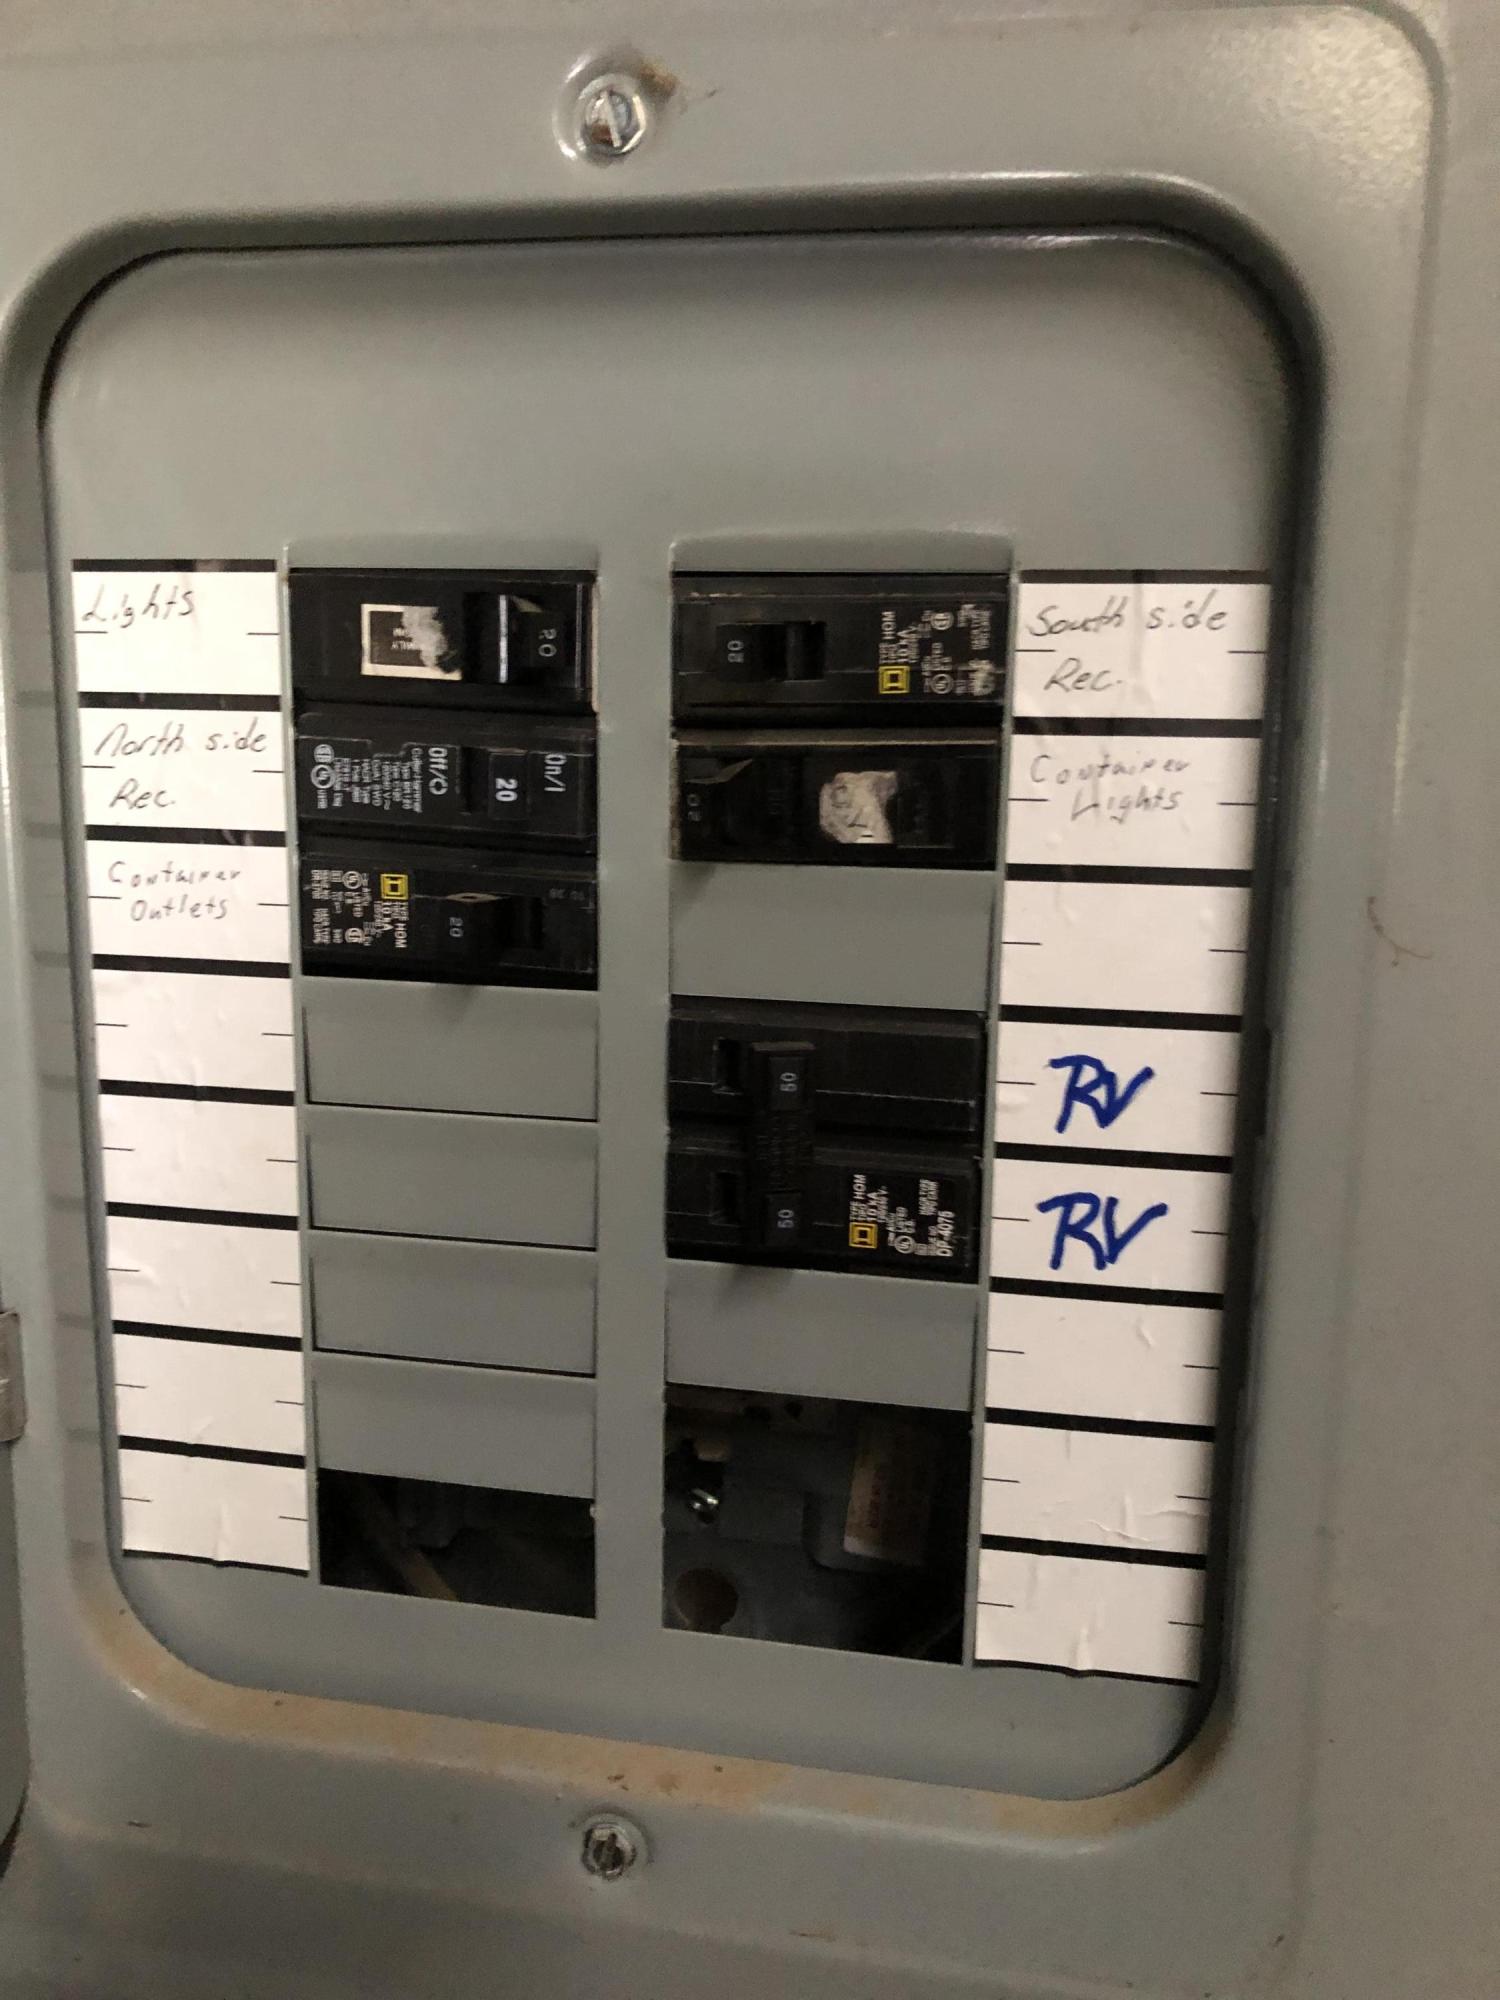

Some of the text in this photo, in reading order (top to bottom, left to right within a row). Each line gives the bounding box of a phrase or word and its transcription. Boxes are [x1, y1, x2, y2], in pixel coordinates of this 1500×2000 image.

[82, 584, 195, 628] Lights
[1026, 595, 1129, 637] South
[1145, 588, 1228, 631] side
[881, 611, 896, 640] HOM
[727, 640, 745, 663] 20
[1044, 657, 1125, 692] Rec.
[94, 716, 267, 757] North side
[1030, 753, 1190, 784] Container
[109, 778, 176, 810] Rec.
[495, 778, 518, 802] 20
[1070, 785, 1184, 824] Lights
[108, 860, 241, 888] Container
[130, 893, 229, 922] Outlets
[394, 923, 407, 948] HOM
[449, 917, 464, 938] 20
[779, 1071, 798, 1093] 50
[1043, 1053, 1155, 1134] RV
[853, 1174, 867, 1199] HOM
[777, 1208, 795, 1230] 50
[1037, 1191, 1169, 1271] RV
